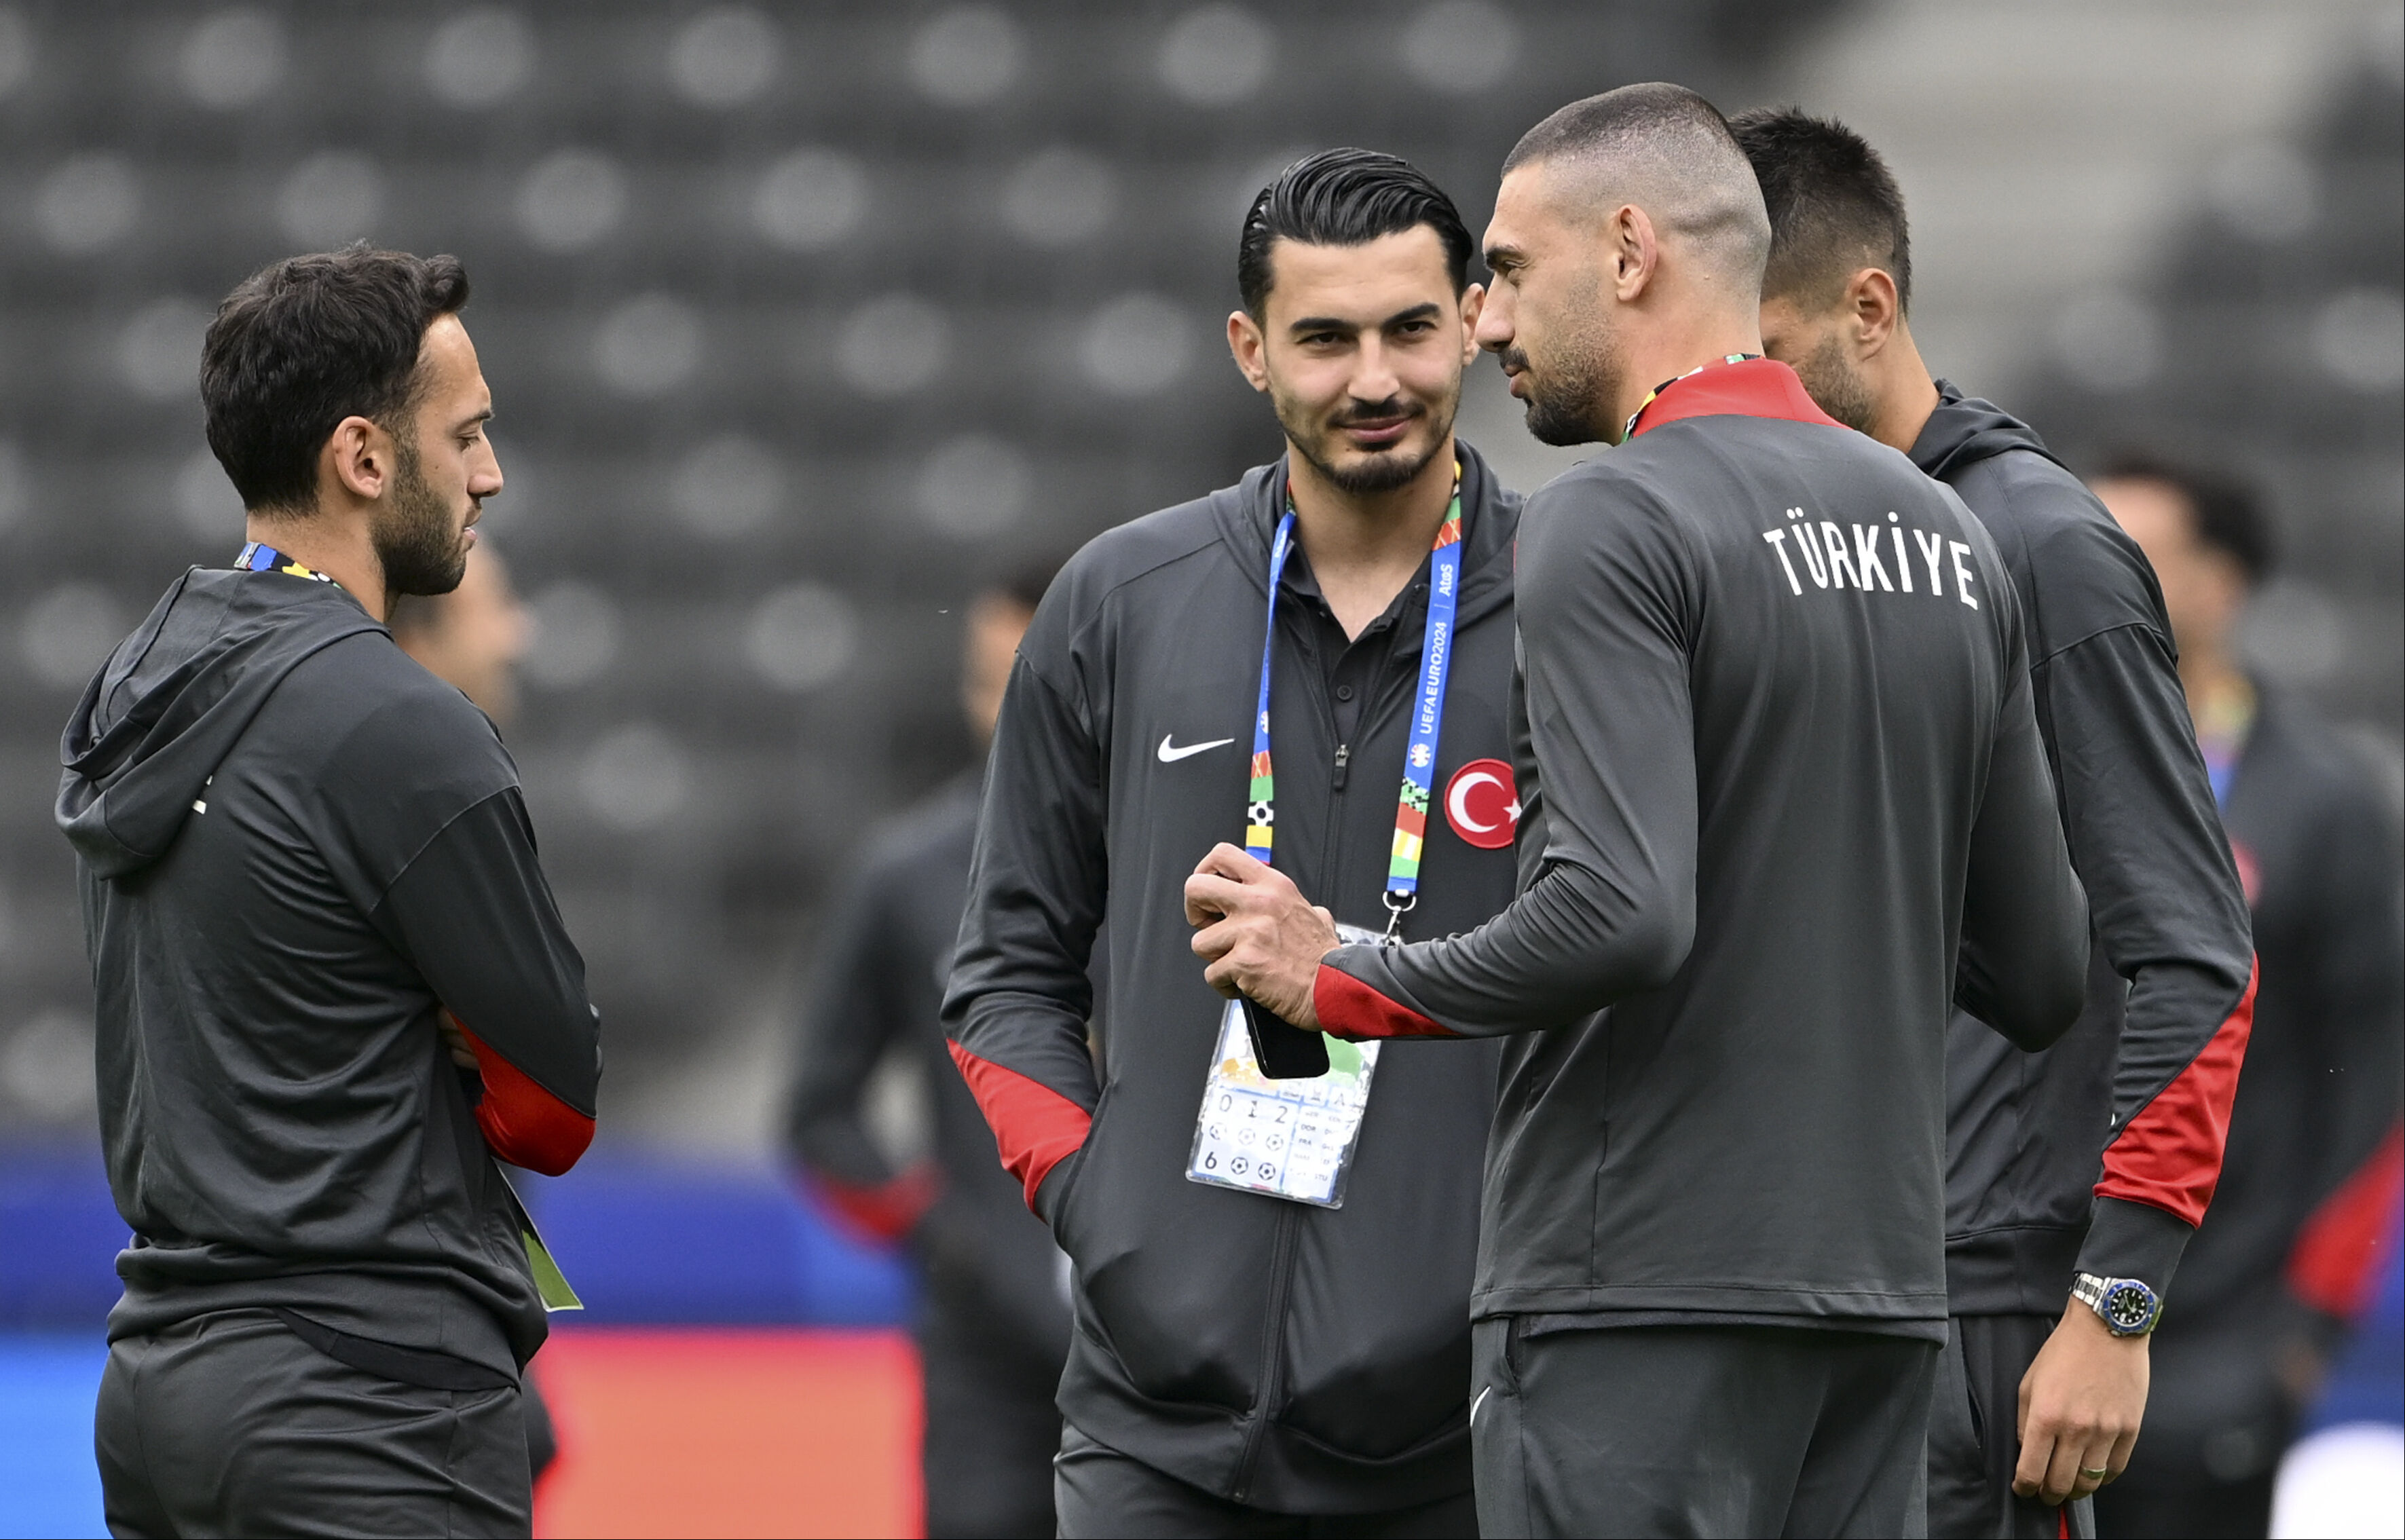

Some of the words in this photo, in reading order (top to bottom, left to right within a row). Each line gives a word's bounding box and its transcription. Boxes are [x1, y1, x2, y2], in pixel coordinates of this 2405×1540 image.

[1763, 506, 1978, 610] TÜRKİYE
[1220, 1094, 1233, 1112] 0
[1248, 1100, 1257, 1119] 1
[1275, 1106, 1288, 1124] 2
[1205, 1151, 1217, 1169] 6
